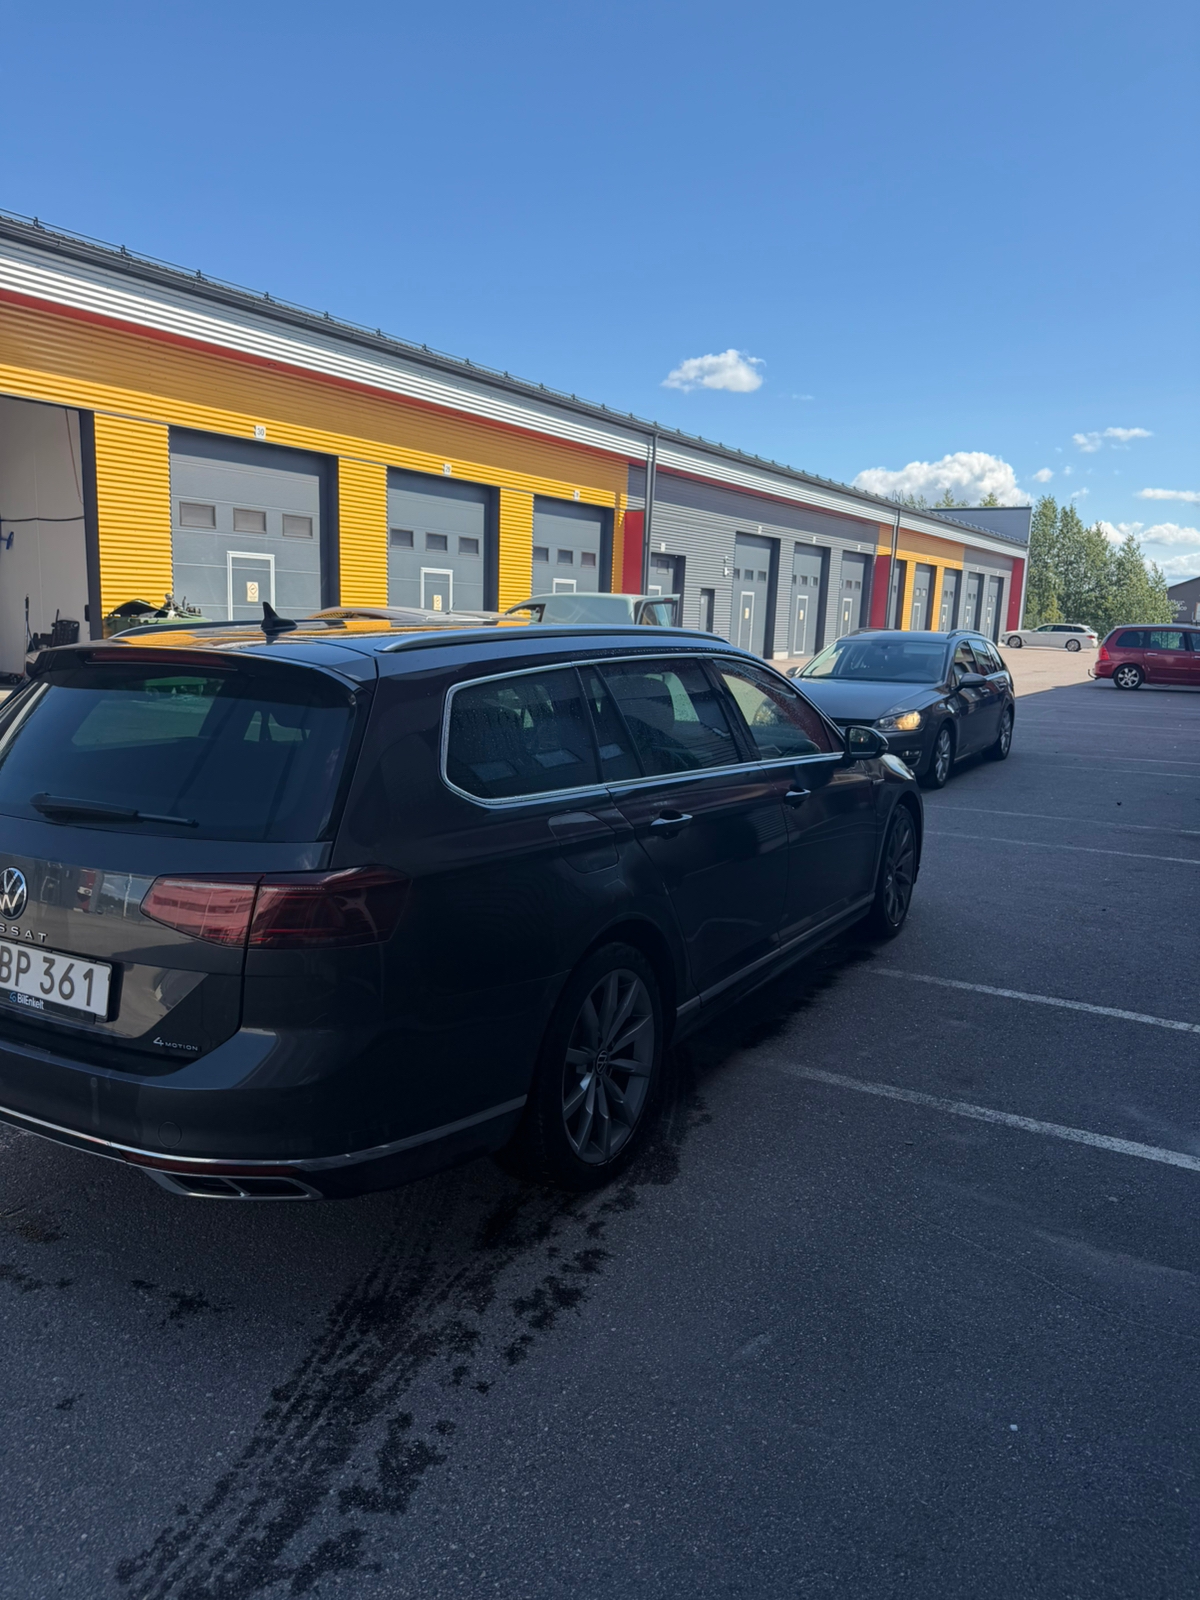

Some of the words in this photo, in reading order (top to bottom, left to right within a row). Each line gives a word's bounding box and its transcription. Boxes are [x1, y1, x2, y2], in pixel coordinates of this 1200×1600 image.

[256, 427, 265, 436] 30
[0, 945, 31, 987] BP
[39, 955, 95, 1008] 361
